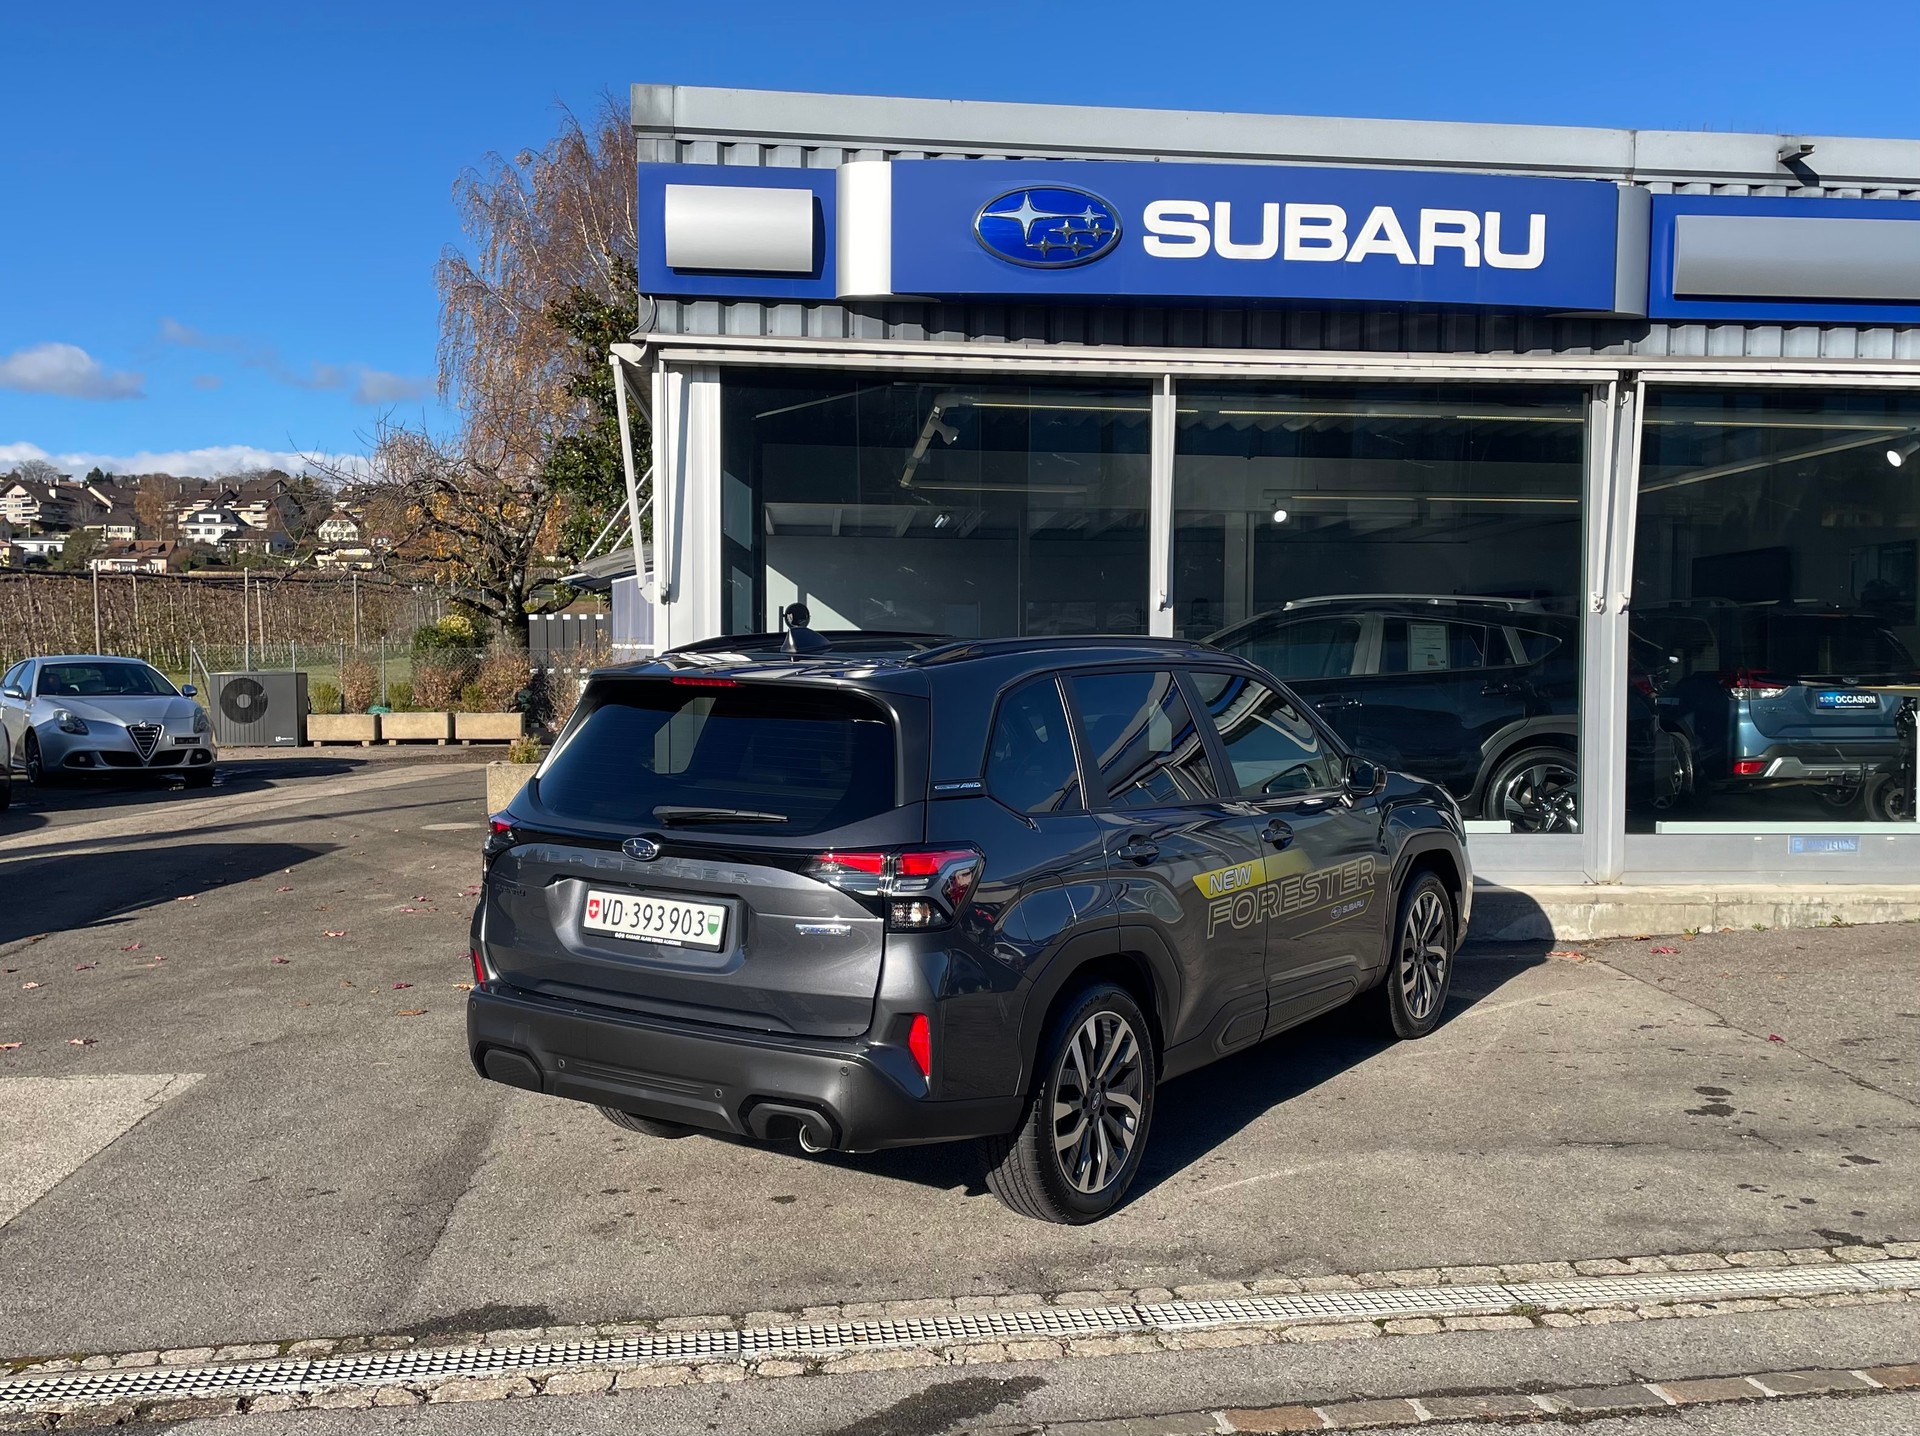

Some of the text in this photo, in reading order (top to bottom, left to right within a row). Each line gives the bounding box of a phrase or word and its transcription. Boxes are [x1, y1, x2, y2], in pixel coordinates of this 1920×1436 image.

[1143, 200, 1546, 270] SUBARU
[1835, 695, 1877, 704] OCCASION
[1209, 865, 1253, 894] NEW
[1206, 854, 1376, 940] FORESTER
[1342, 899, 1365, 915] SUBARU
